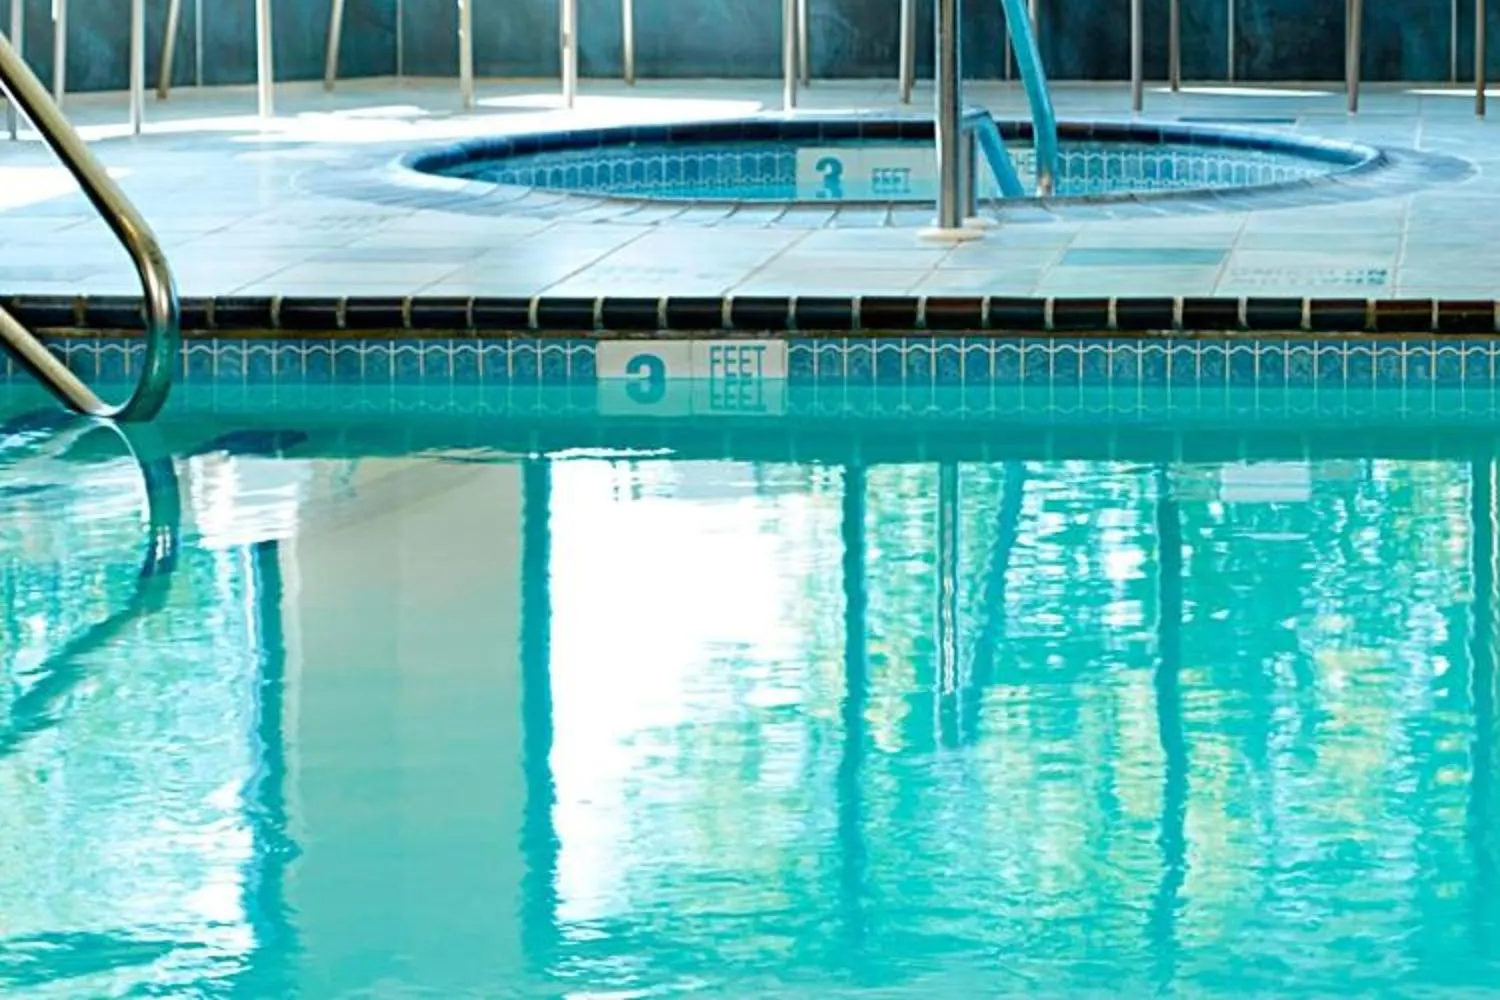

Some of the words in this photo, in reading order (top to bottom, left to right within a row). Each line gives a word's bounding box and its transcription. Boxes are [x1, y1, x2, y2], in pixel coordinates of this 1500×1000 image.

[815, 157, 843, 198] 3
[872, 168, 911, 193] FEET
[709, 346, 766, 378] FEET
